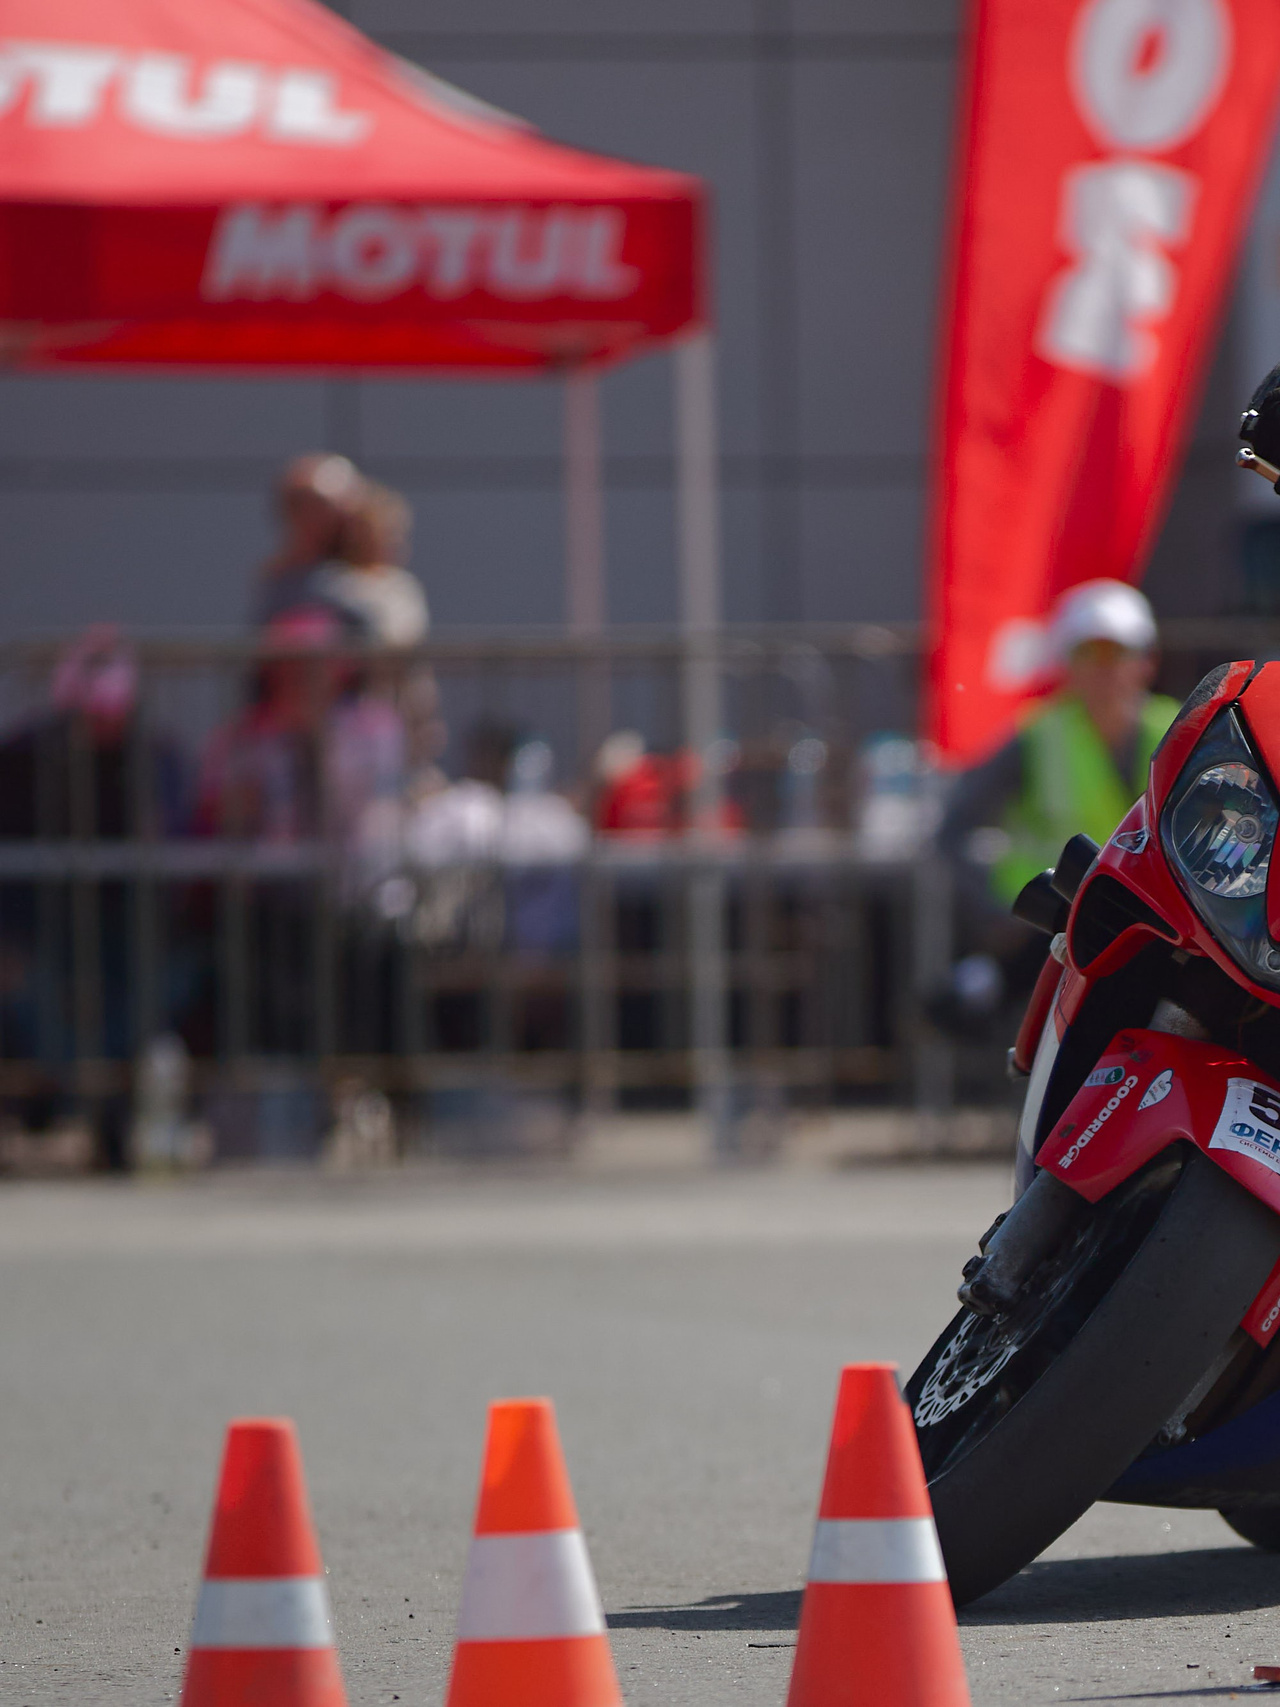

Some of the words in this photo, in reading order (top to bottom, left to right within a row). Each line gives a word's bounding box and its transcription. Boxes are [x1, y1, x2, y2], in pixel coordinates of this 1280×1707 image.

[0, 43, 371, 145] TUL
[202, 204, 640, 301] MOTUL
[1058, 1075, 1138, 1169] GOODRIDGE
[1239, 1139, 1275, 1160] СИСТЕМЫ
